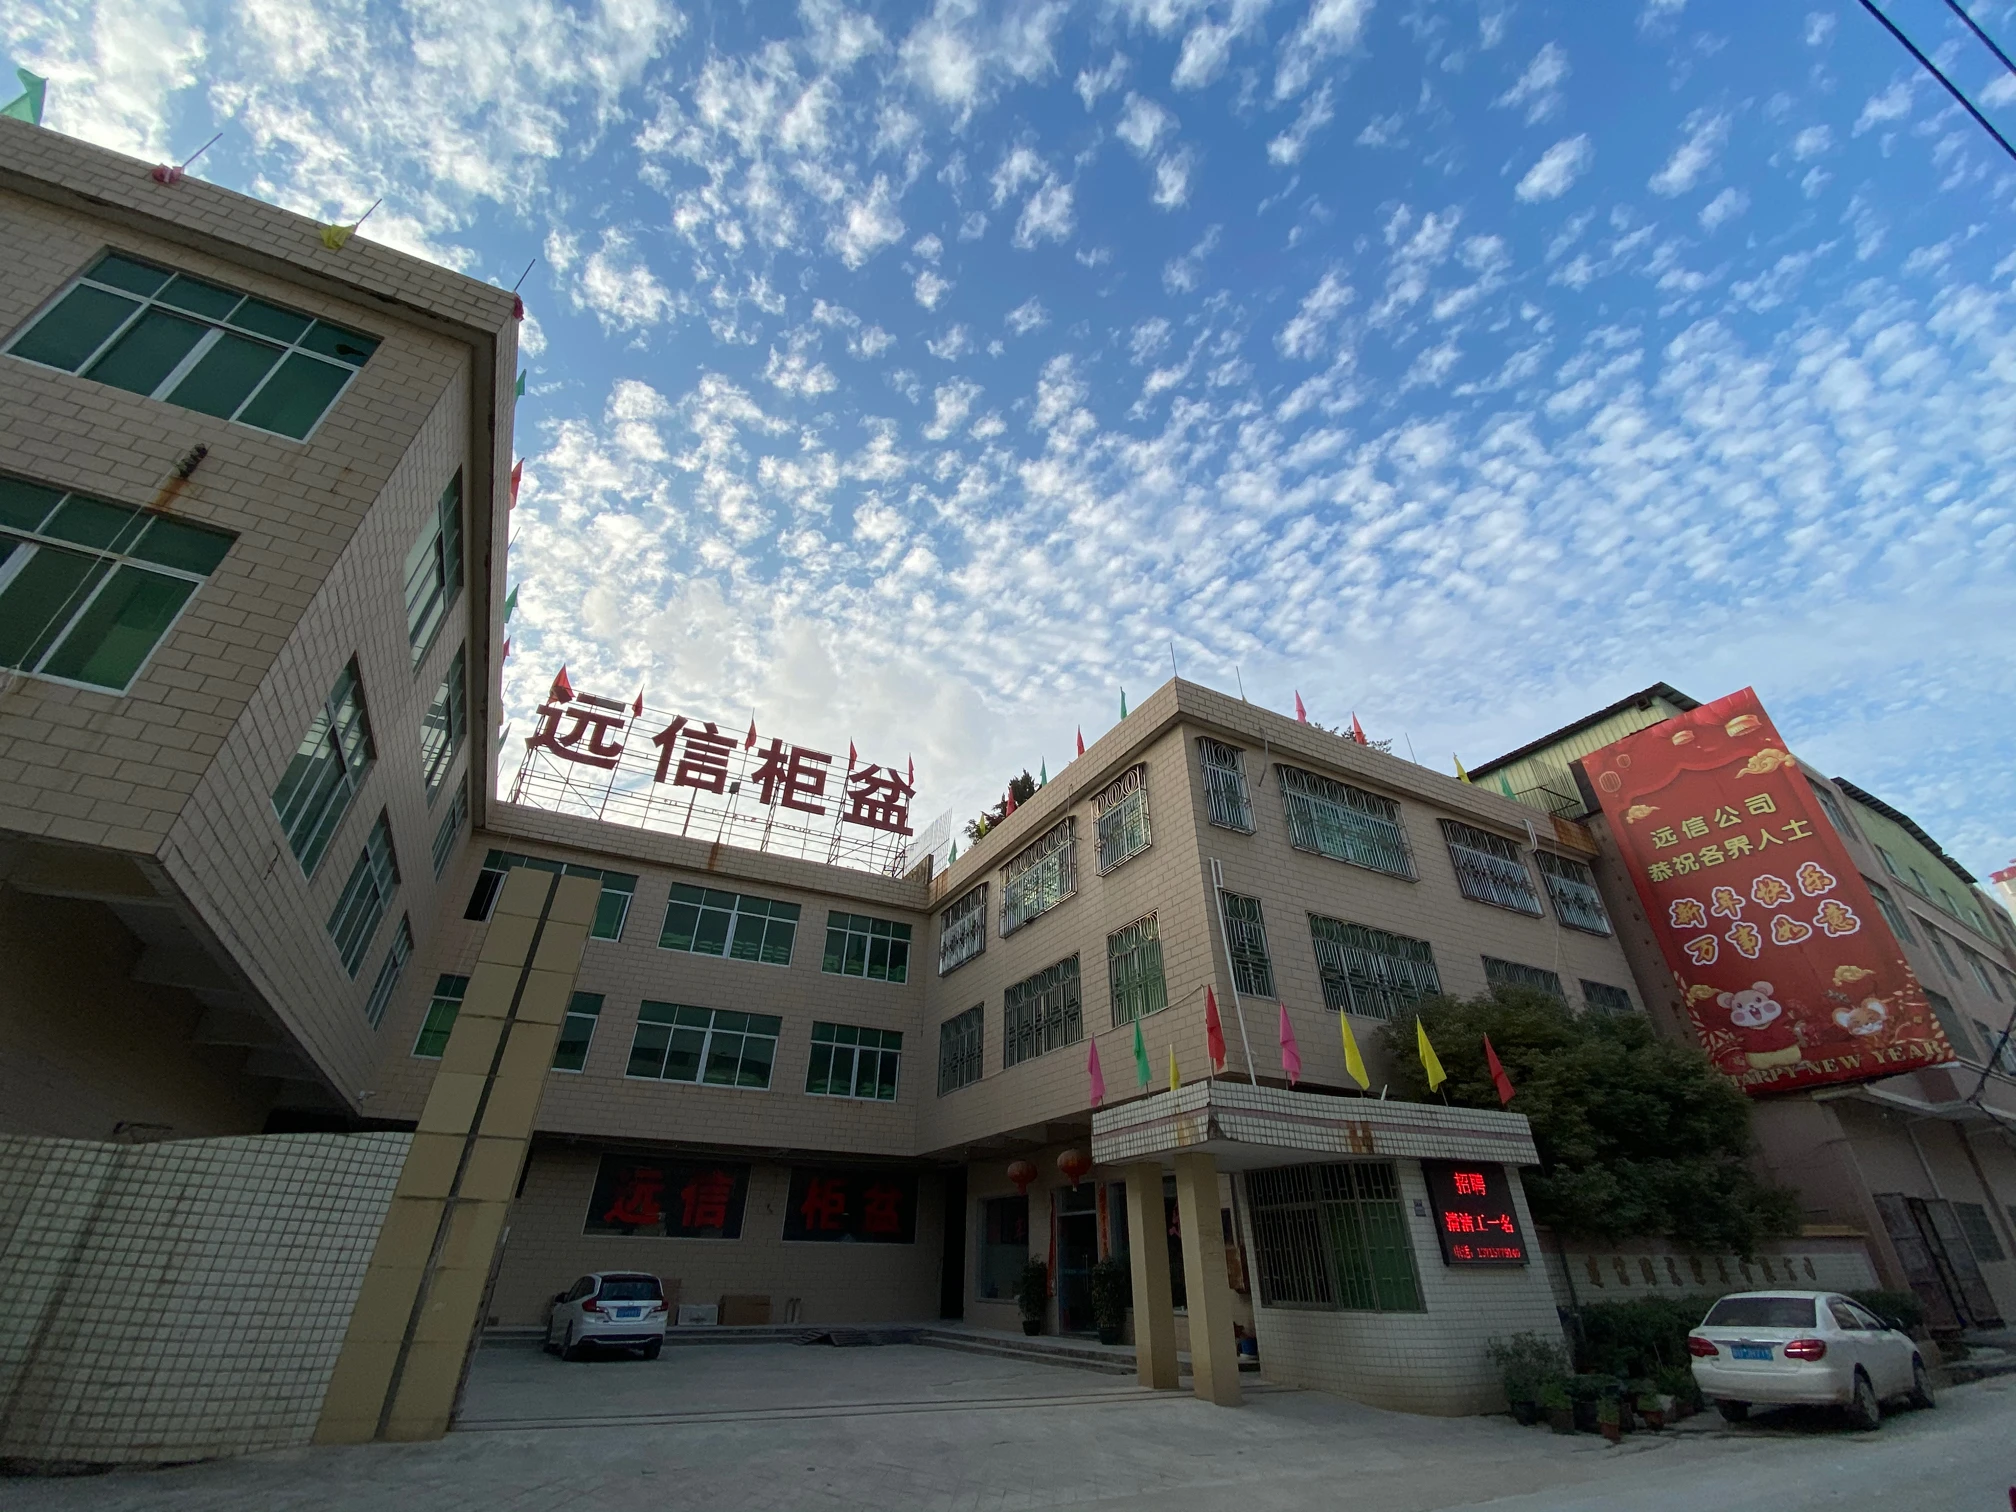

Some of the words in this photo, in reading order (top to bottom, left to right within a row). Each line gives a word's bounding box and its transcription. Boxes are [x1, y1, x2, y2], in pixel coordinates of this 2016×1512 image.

[525, 687, 916, 837] 远信柜盆
[1648, 818, 1813, 883] 恭祝各界人士
[1649, 793, 1776, 850] 远信公司
[1669, 862, 1836, 928] 新年快乐
[1684, 899, 1861, 965] 万事如意
[1803, 1054, 1860, 1076] NEW
[1871, 1039, 1944, 1065] YEAR
[604, 1167, 735, 1229] 远信
[1453, 1171, 1487, 1196] 招聘
